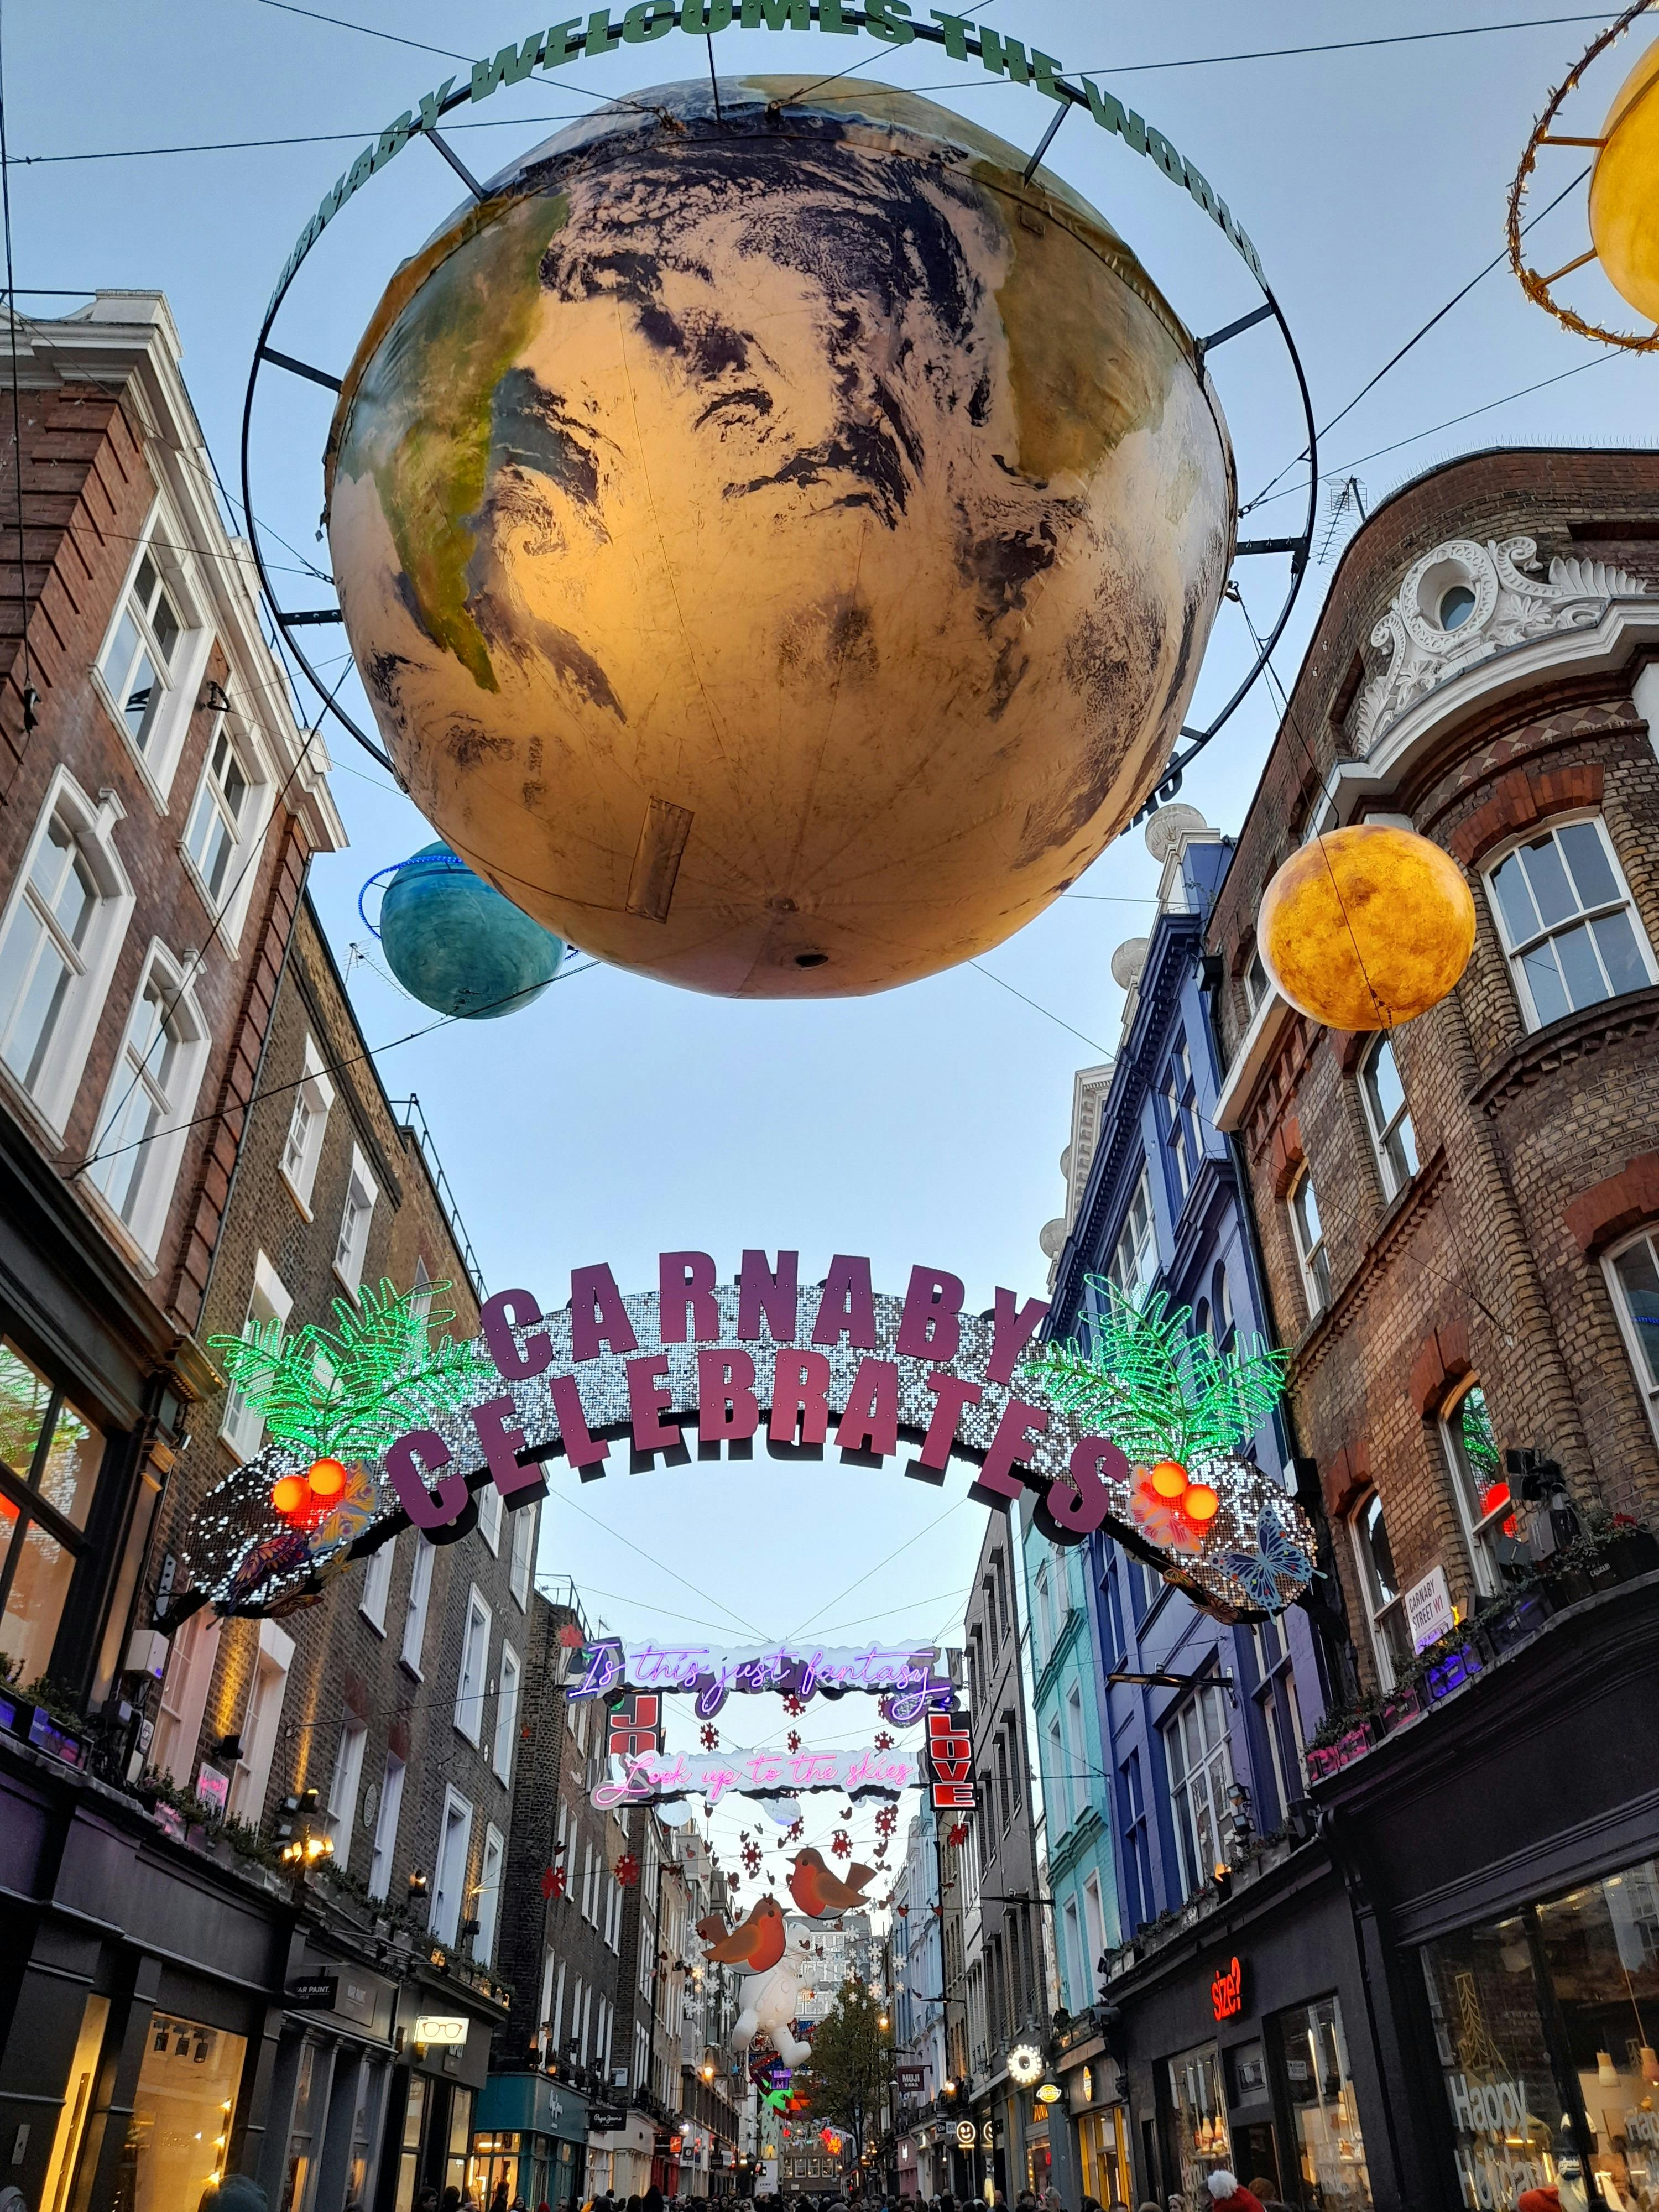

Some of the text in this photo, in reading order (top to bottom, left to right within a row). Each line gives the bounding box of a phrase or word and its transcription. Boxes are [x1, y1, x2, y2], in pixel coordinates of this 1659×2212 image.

[472, 0, 915, 103] WELCOMES
[930, 9, 1070, 105] THE
[1081, 74, 1268, 292] WORLD
[480, 1249, 1051, 1385] CARNABY
[387, 1348, 1128, 1533] CELEBRATES
[1408, 1578, 1436, 1613] CARNABY
[1412, 1594, 1444, 1631] STREET W1
[568, 1642, 951, 1721] Is this just fantasy
[595, 1751, 914, 1804] Look up to the skies
[928, 1714, 975, 1807] LOVE
[1212, 1956, 1241, 2021] size?
[902, 2074, 920, 2083] MUJI
[1449, 2073, 1528, 2142] Happy
